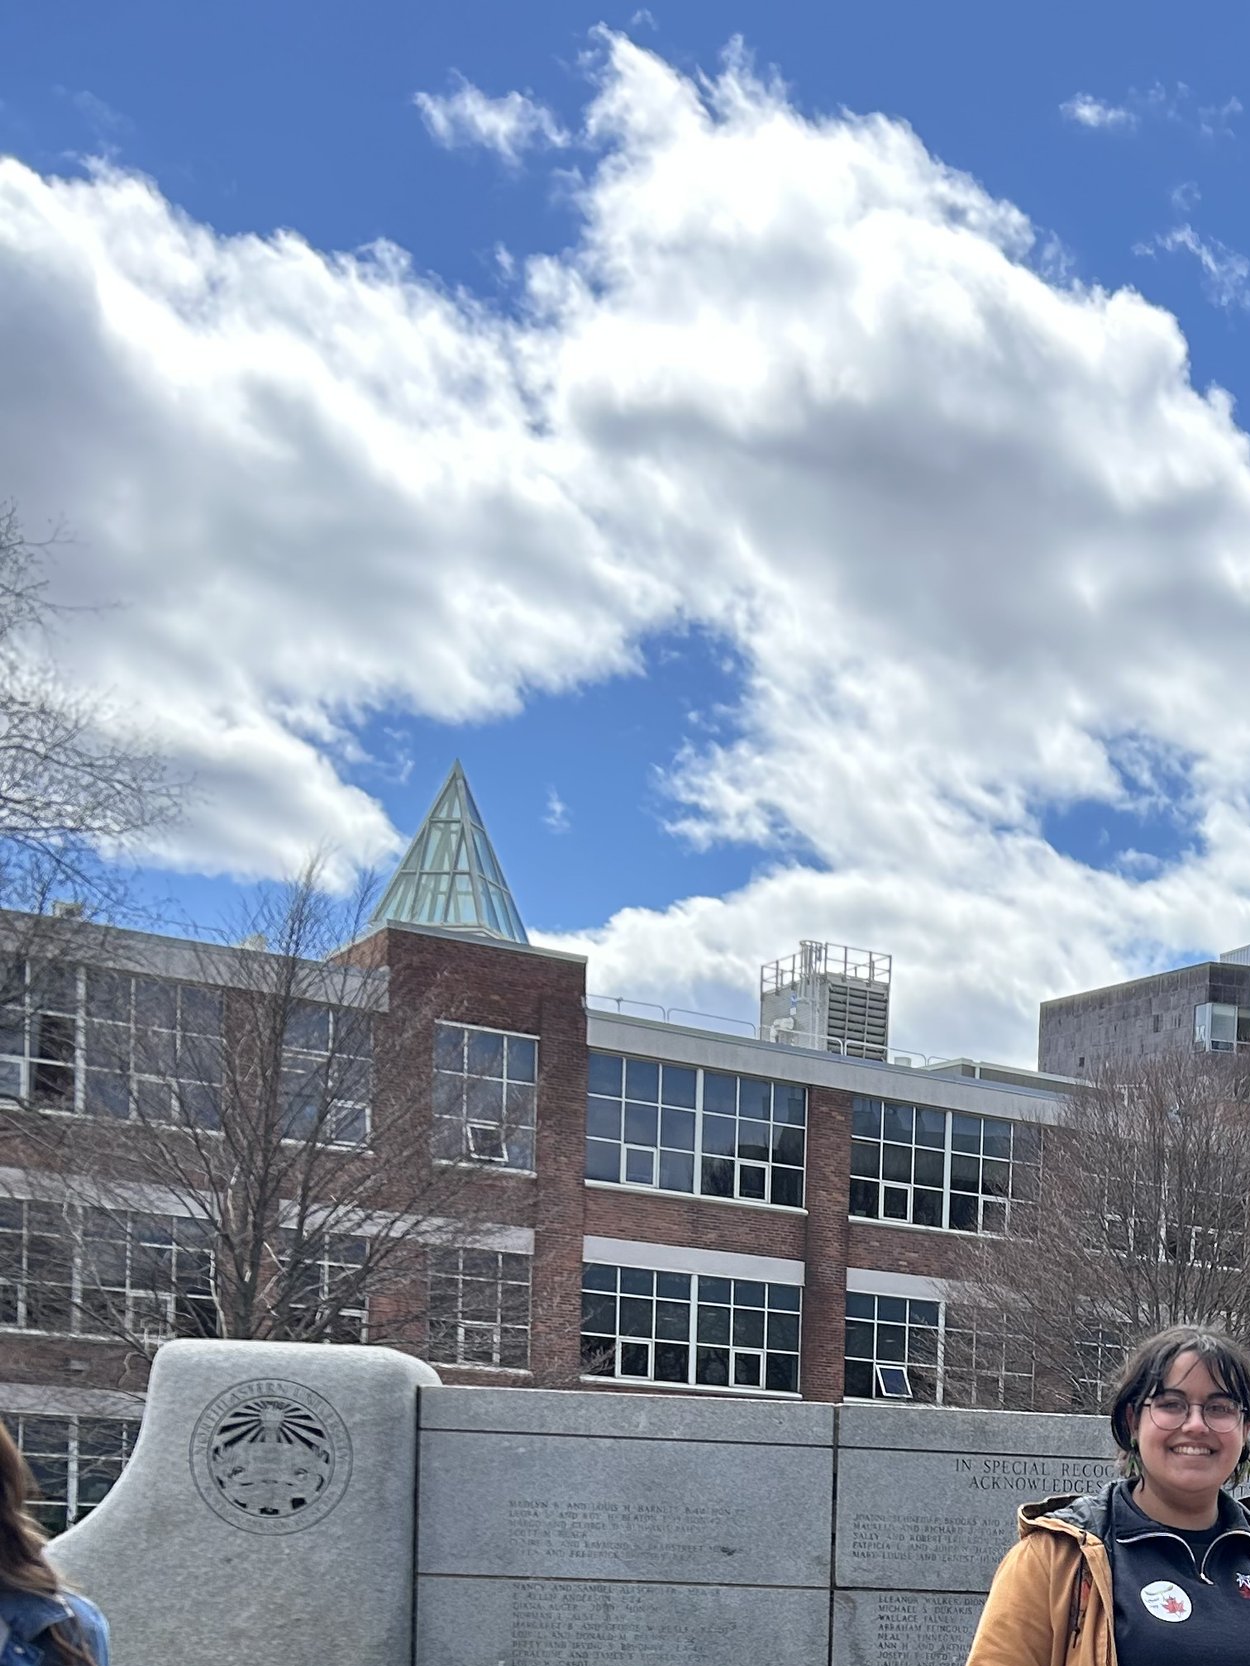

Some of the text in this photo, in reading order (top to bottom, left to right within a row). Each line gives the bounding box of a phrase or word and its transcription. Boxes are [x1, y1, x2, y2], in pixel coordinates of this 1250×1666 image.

[955, 1458, 977, 1472] IN
[983, 1459, 1050, 1476] SPECIAL
[968, 1476, 1105, 1494] ACKNOWLEDGES
[878, 1605, 917, 1614] MICHAEL
[935, 1606, 972, 1615] DUKAKIS
[878, 1614, 917, 1622] WALLACE
[878, 1623, 922, 1632] ABRAHAM
